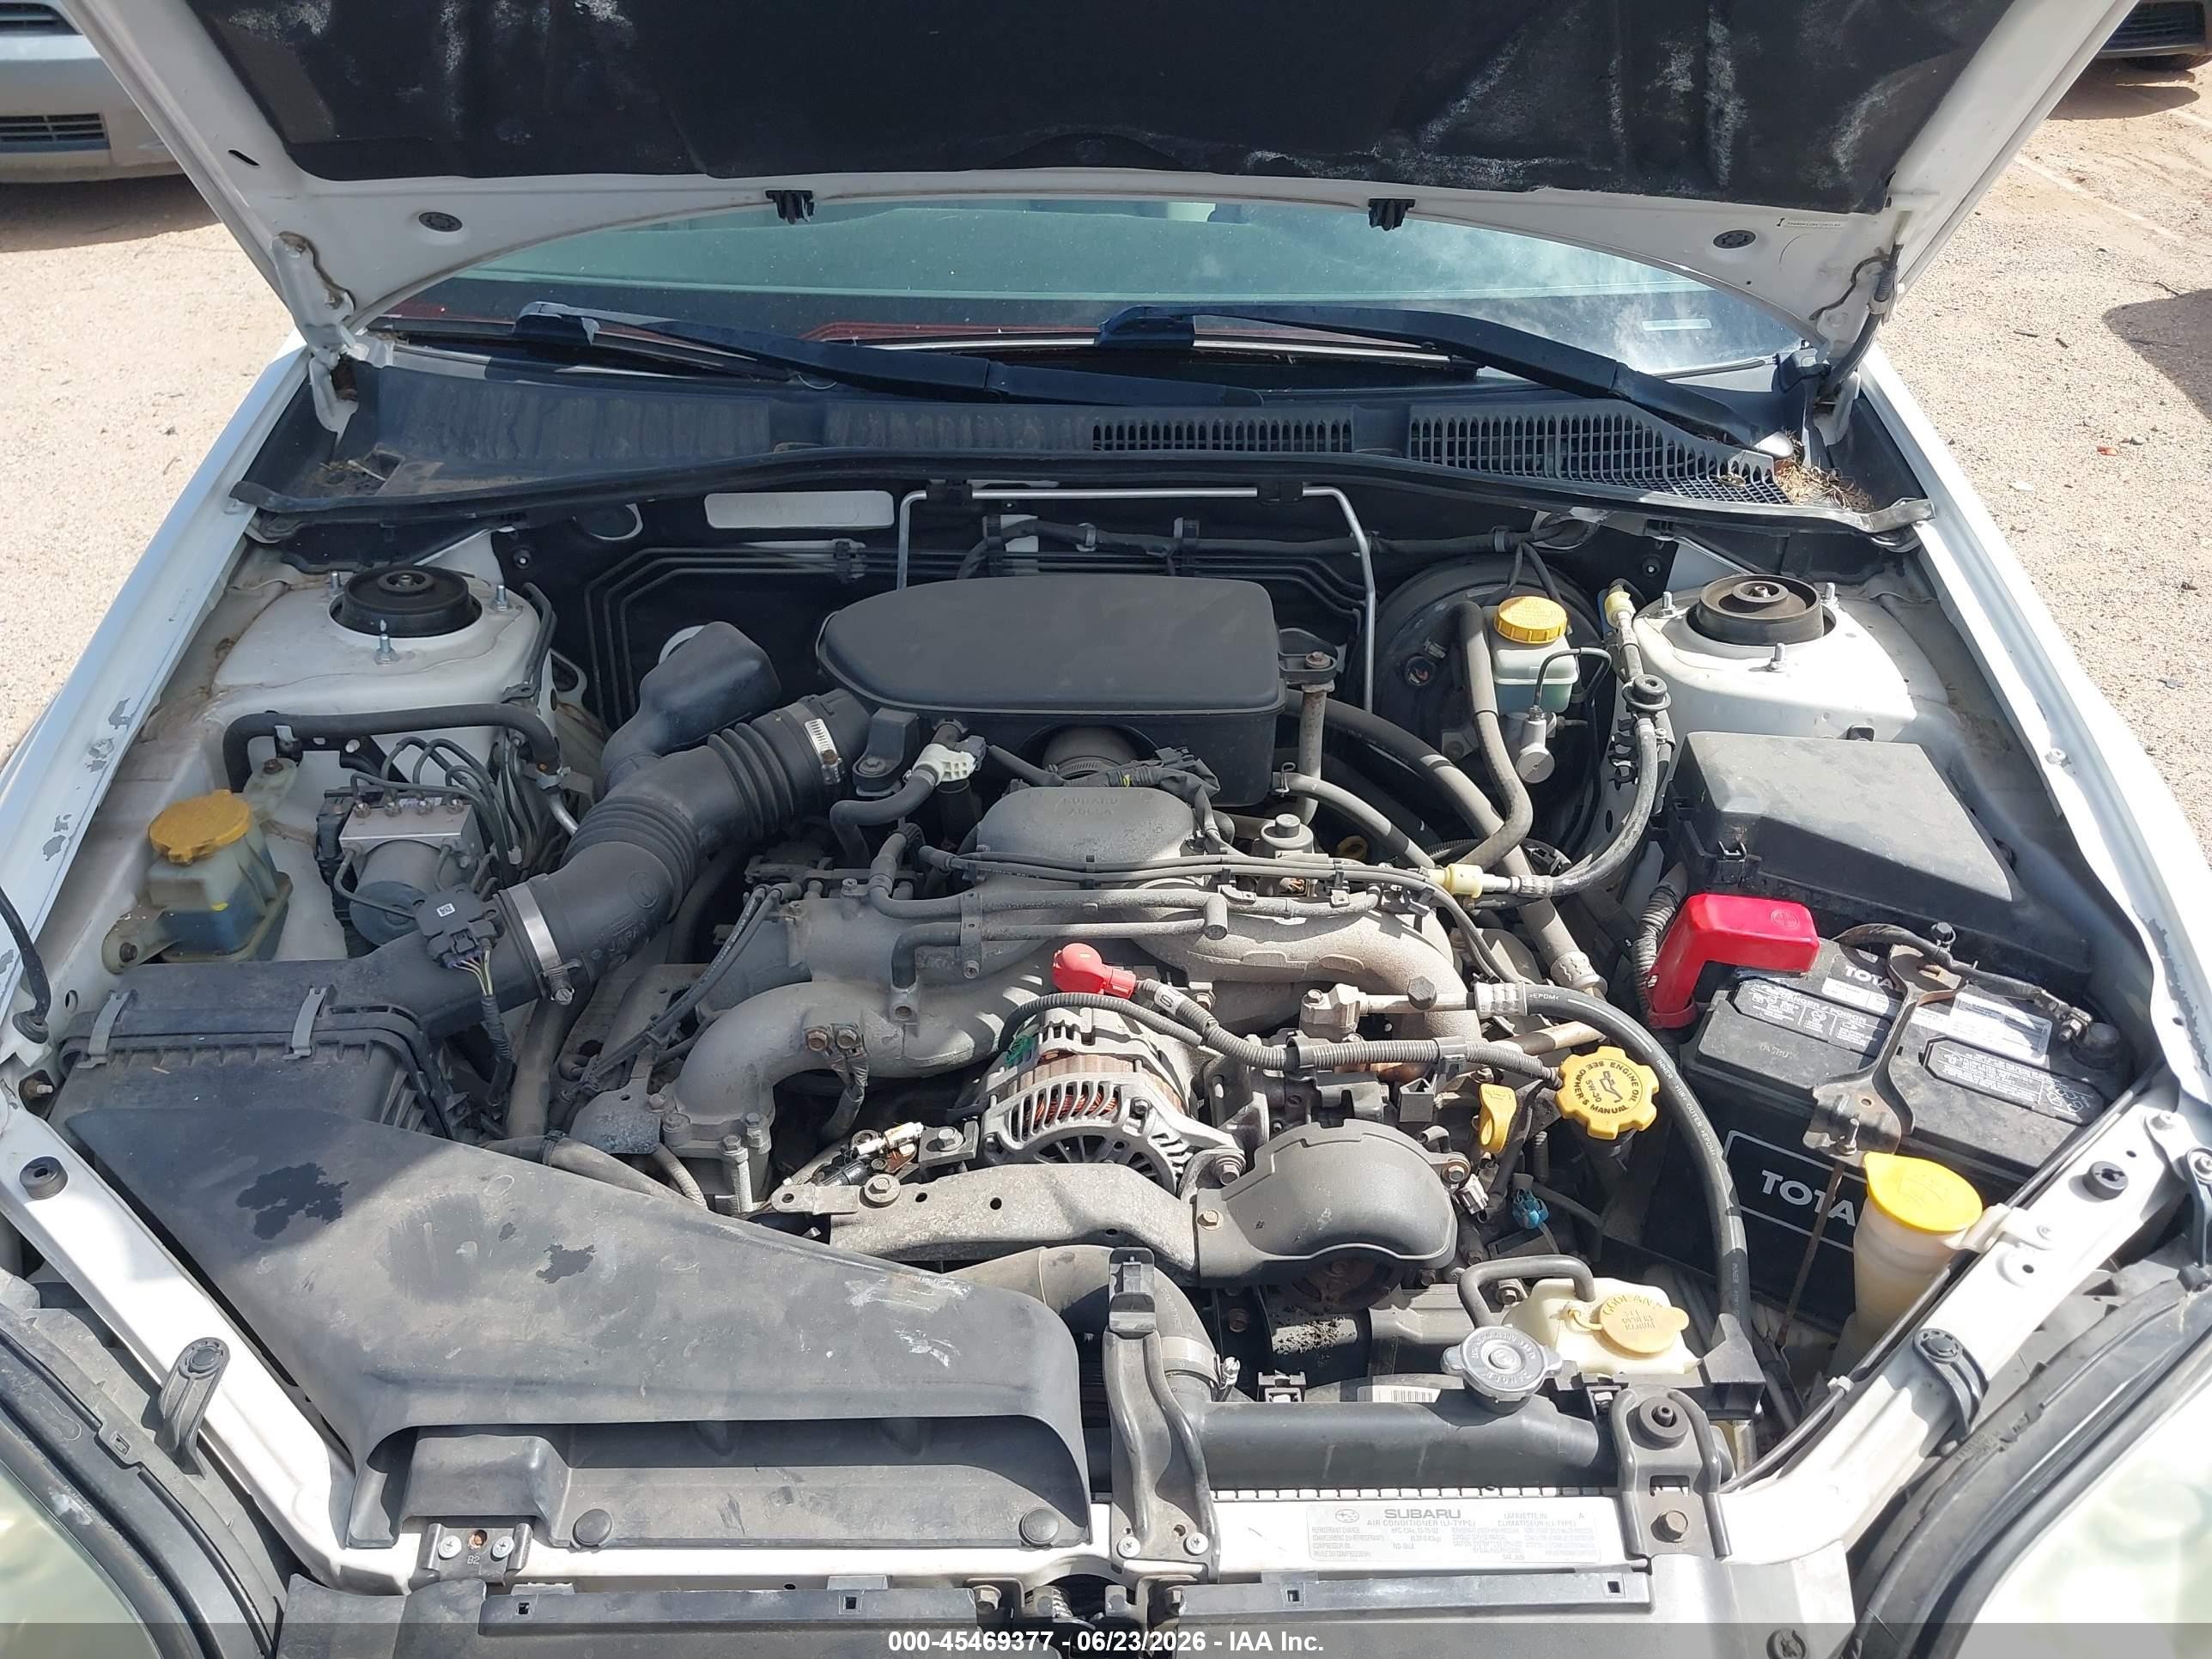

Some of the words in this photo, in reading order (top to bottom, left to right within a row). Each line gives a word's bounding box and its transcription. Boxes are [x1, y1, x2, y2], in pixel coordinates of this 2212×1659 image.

[1845, 965, 1894, 989] TOTA
[1587, 1060, 1605, 1071] SEE
[1573, 1069, 1589, 1106] OWNER'S
[1585, 1079, 1602, 1103] 5W-30
[1609, 1061, 1639, 1088] ENGINE
[1628, 1089, 1639, 1103] OIL
[1656, 1059, 1674, 1079] INNER
[1686, 1103, 1703, 1127] OUTER
[1590, 1103, 1630, 1115] MANUAL
[1761, 1169, 1856, 1227] TOTA
[1384, 1508, 1462, 1519] SUBARU
